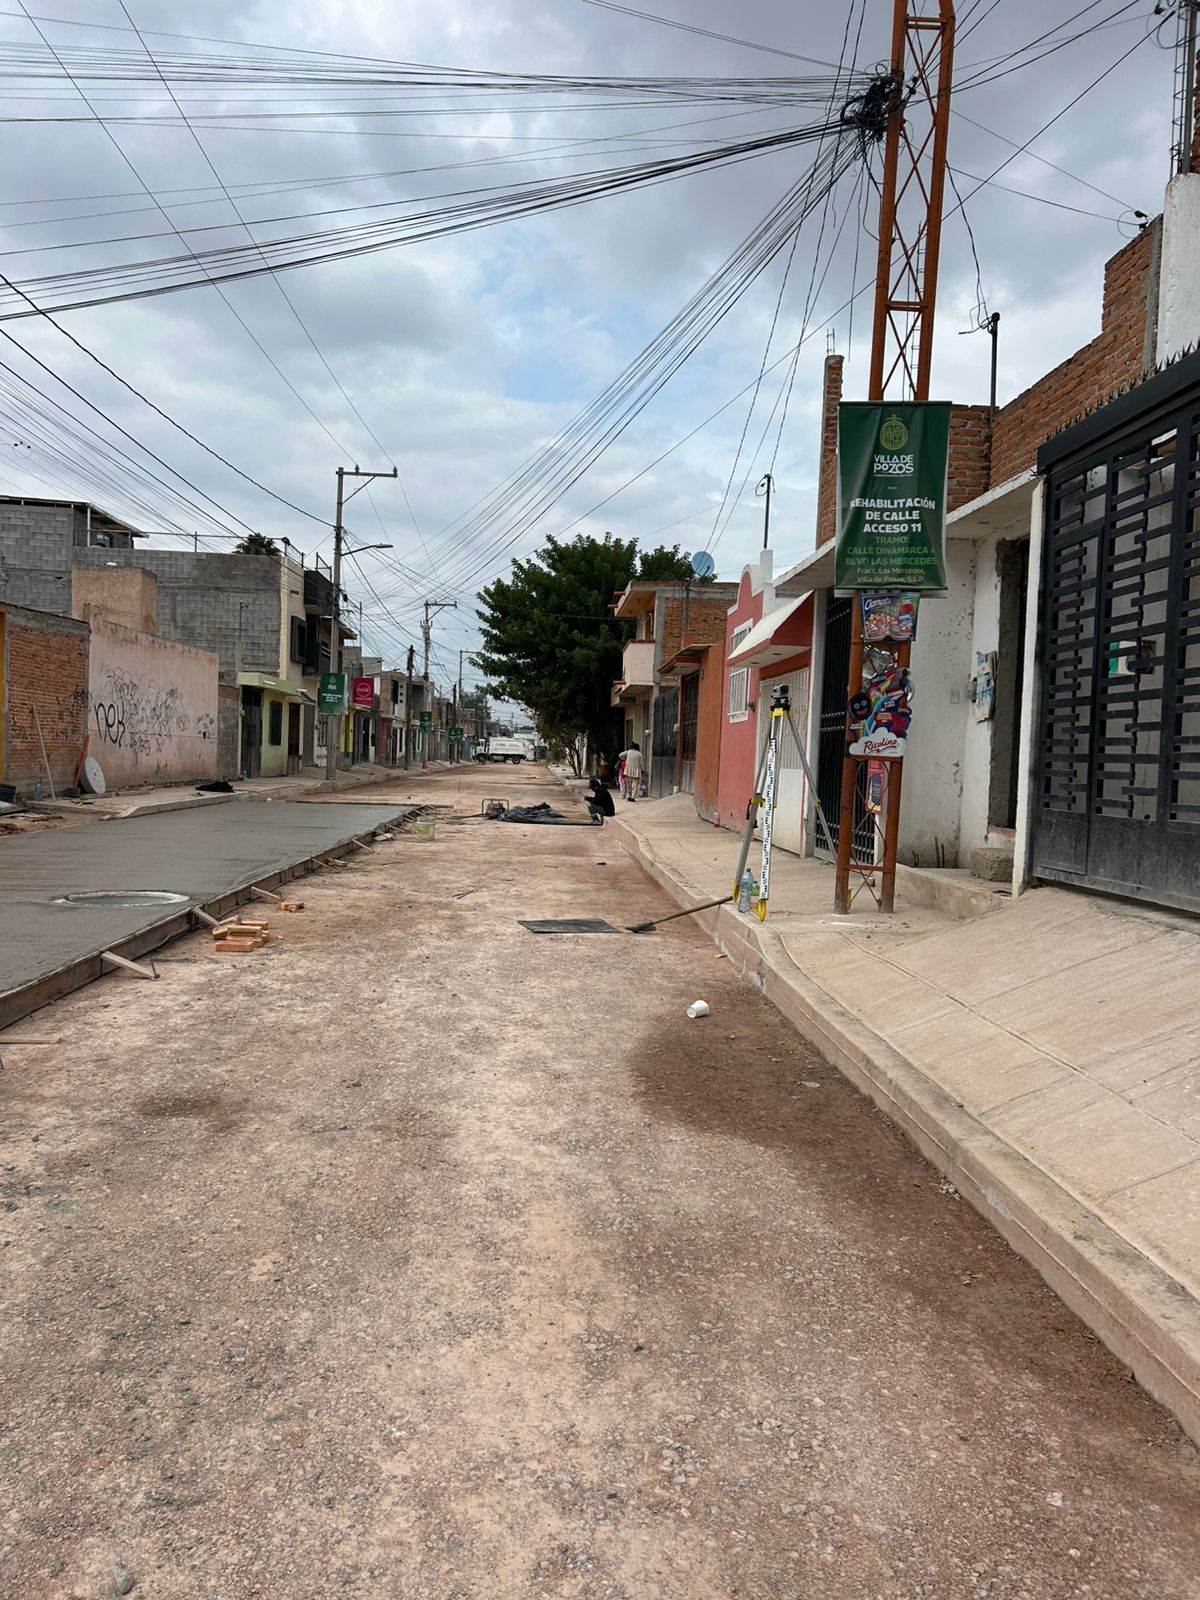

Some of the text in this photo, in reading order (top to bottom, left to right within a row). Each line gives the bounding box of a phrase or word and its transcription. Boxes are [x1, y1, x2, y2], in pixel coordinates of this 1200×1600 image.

[874, 454, 914, 463] VILLA DE
[866, 510, 920, 521] DE CALLE
[863, 523, 922, 533] ACCESO 11
[875, 536, 910, 544] TRAMO:
[847, 547, 874, 555] CALLE
[876, 546, 928, 555] DINAMARCA
[846, 557, 936, 566] BLVD LAS MERCEDES
[863, 738, 898, 754] Ricolino
